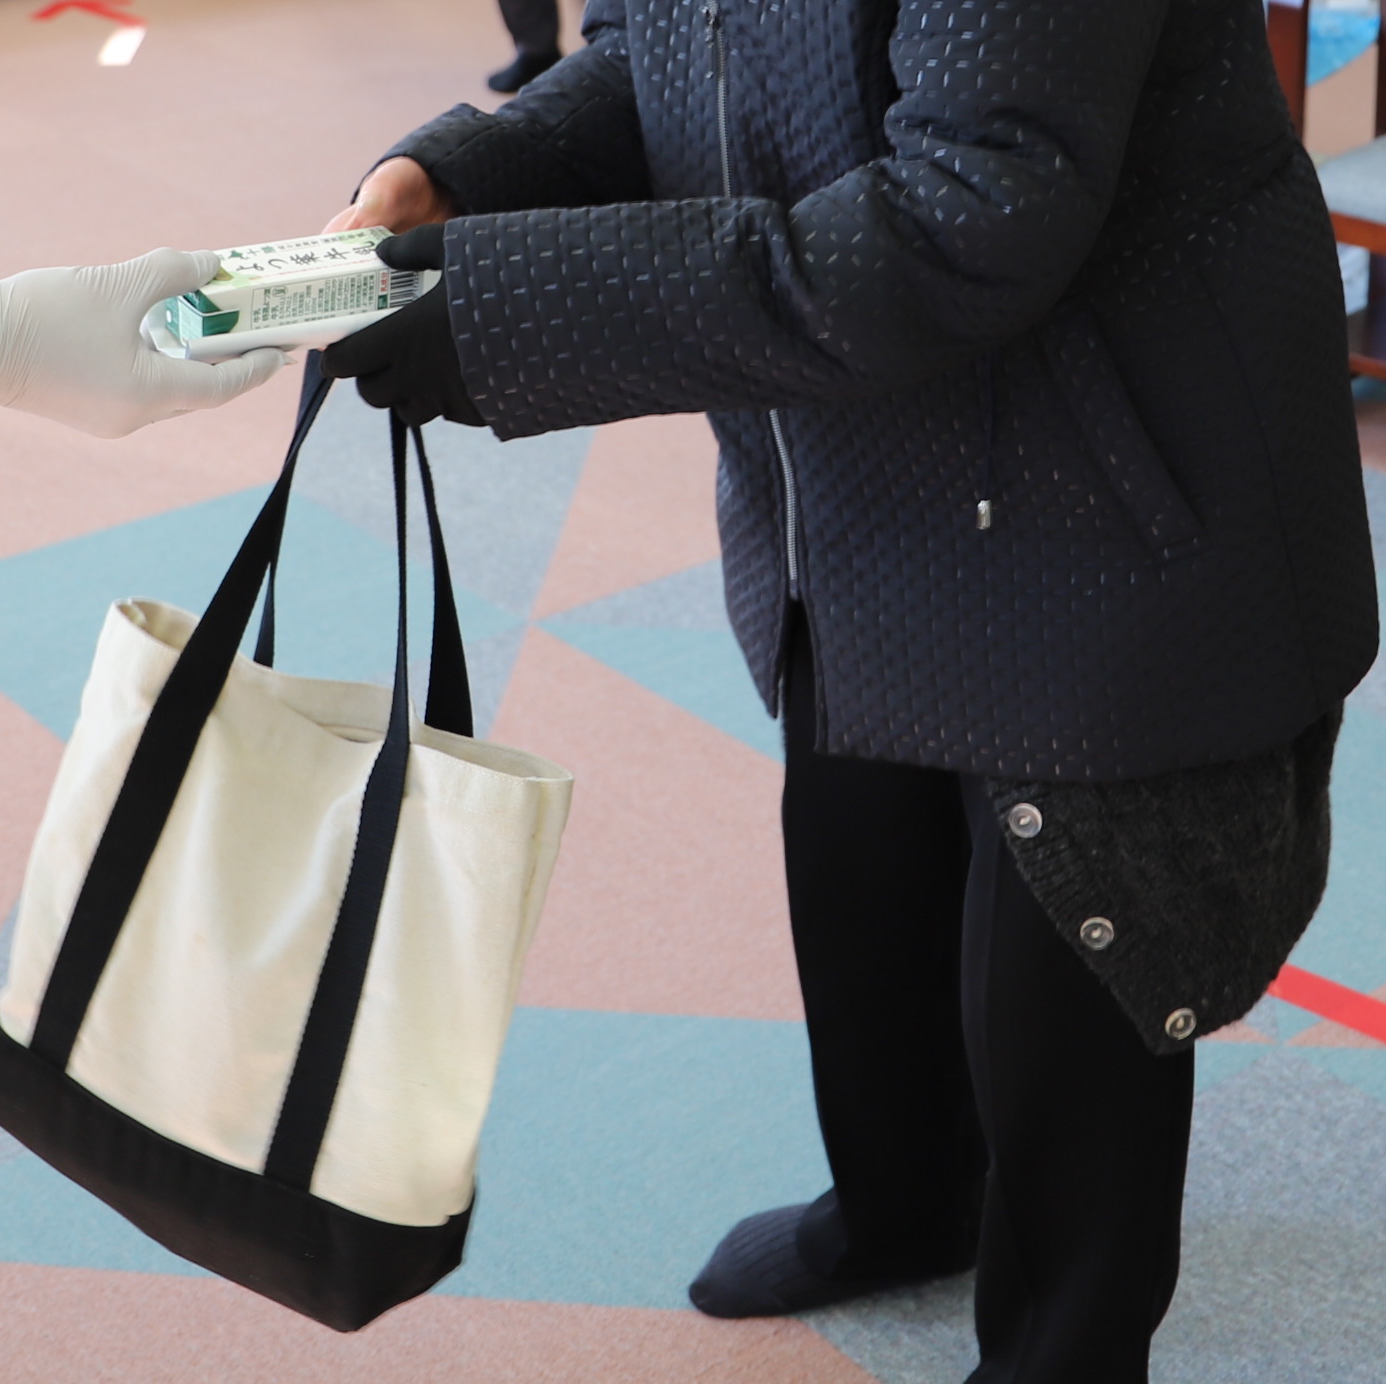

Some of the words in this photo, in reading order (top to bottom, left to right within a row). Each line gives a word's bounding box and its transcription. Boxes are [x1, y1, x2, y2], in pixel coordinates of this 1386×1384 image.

[235, 239, 376, 272] よつ葉牛乳
